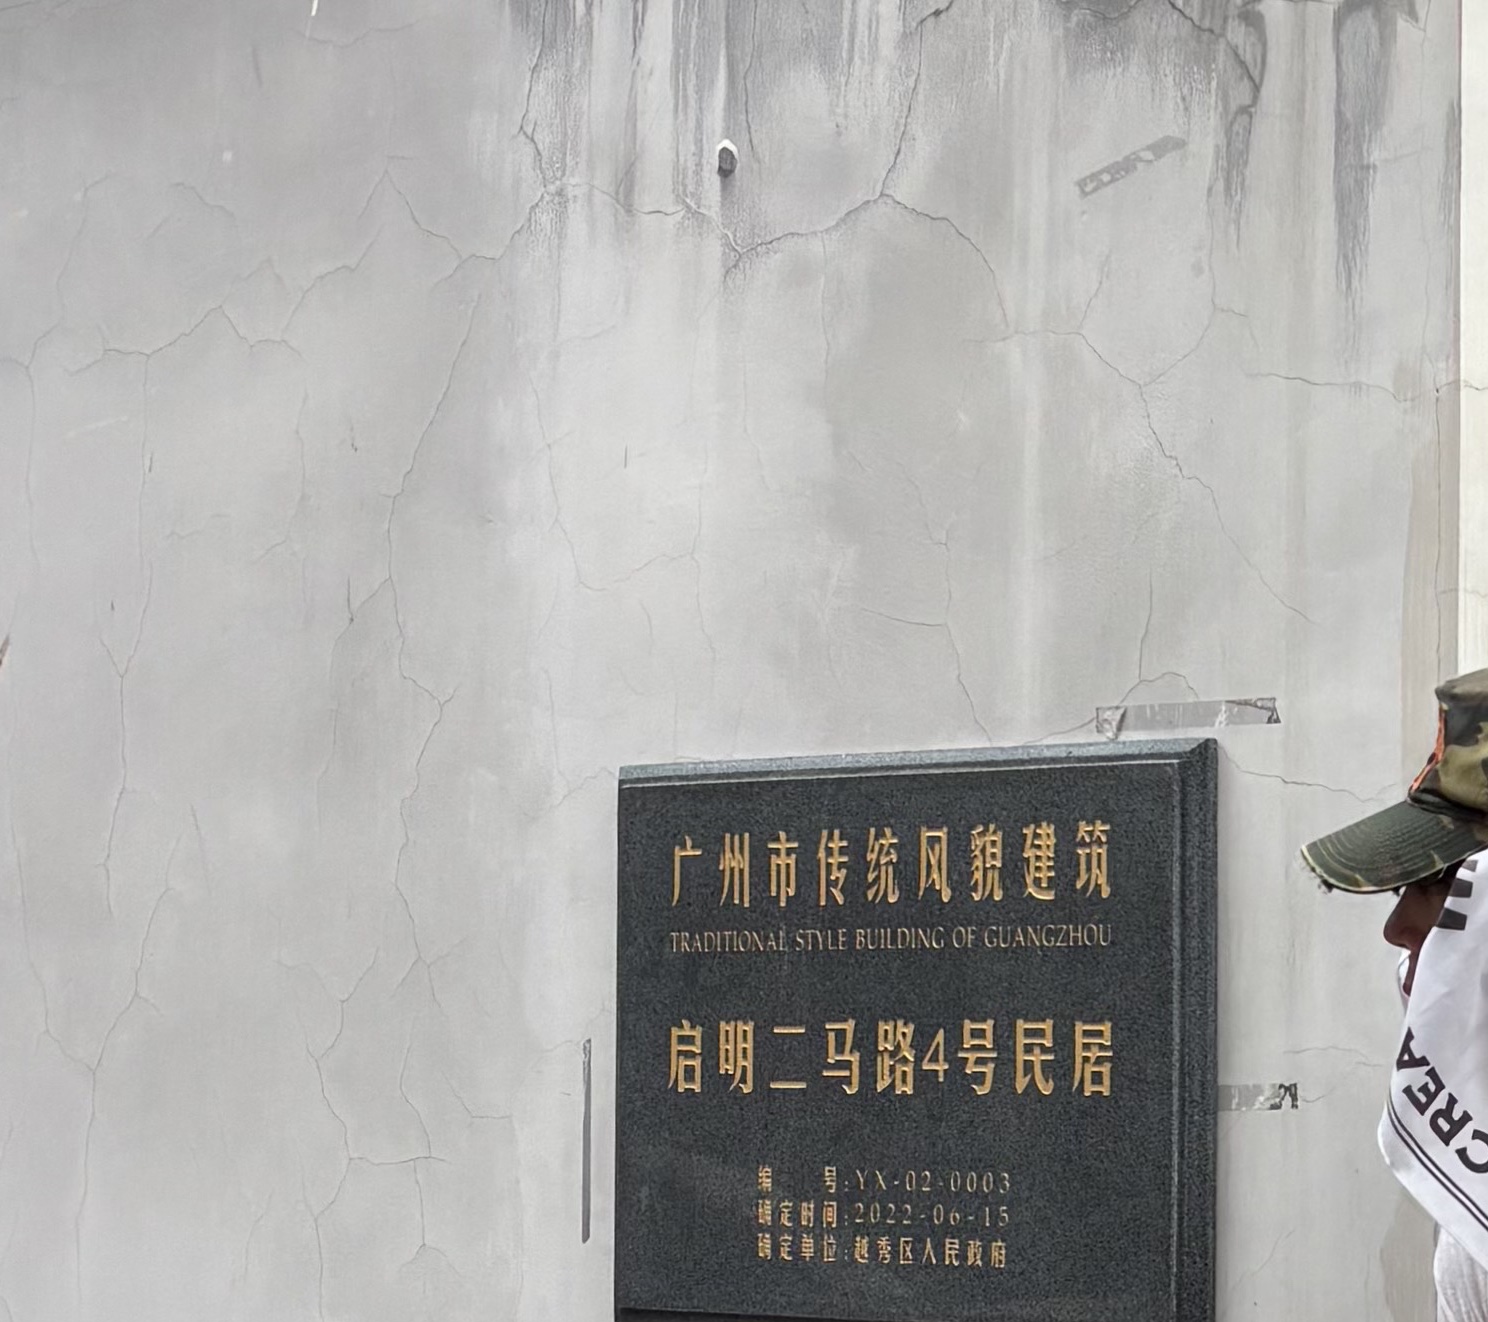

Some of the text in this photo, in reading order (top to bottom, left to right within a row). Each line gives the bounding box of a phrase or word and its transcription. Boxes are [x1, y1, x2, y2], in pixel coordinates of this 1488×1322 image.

[671, 820, 1112, 908] 广州市传统风貌建筑
[670, 923, 1112, 953] TRADITIONAL STYLE BUILDING OF GUANGZHOU
[668, 1018, 1114, 1097] 启明二马路4号民居
